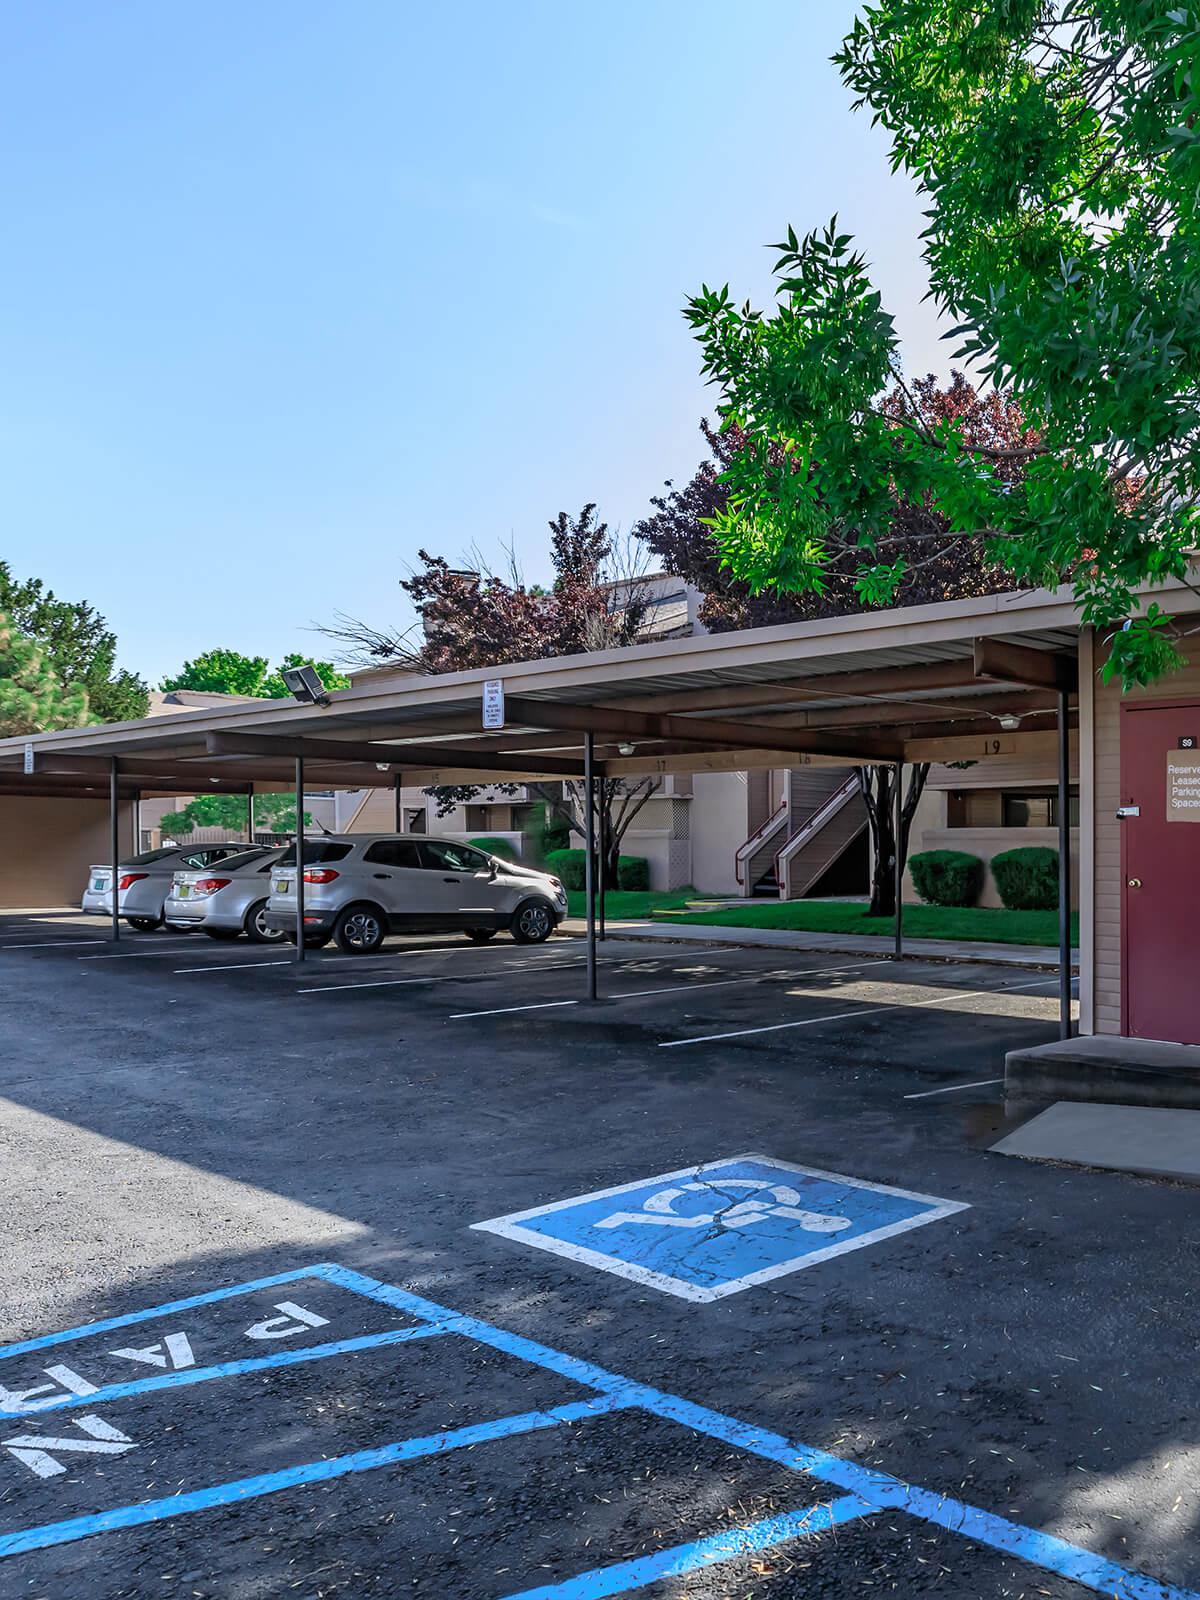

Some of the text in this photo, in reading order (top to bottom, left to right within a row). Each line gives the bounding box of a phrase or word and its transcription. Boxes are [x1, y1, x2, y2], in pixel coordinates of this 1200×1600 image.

[984, 740, 1001, 755] 19
[1182, 738, 1192, 747] S9
[656, 760, 666, 771] 17
